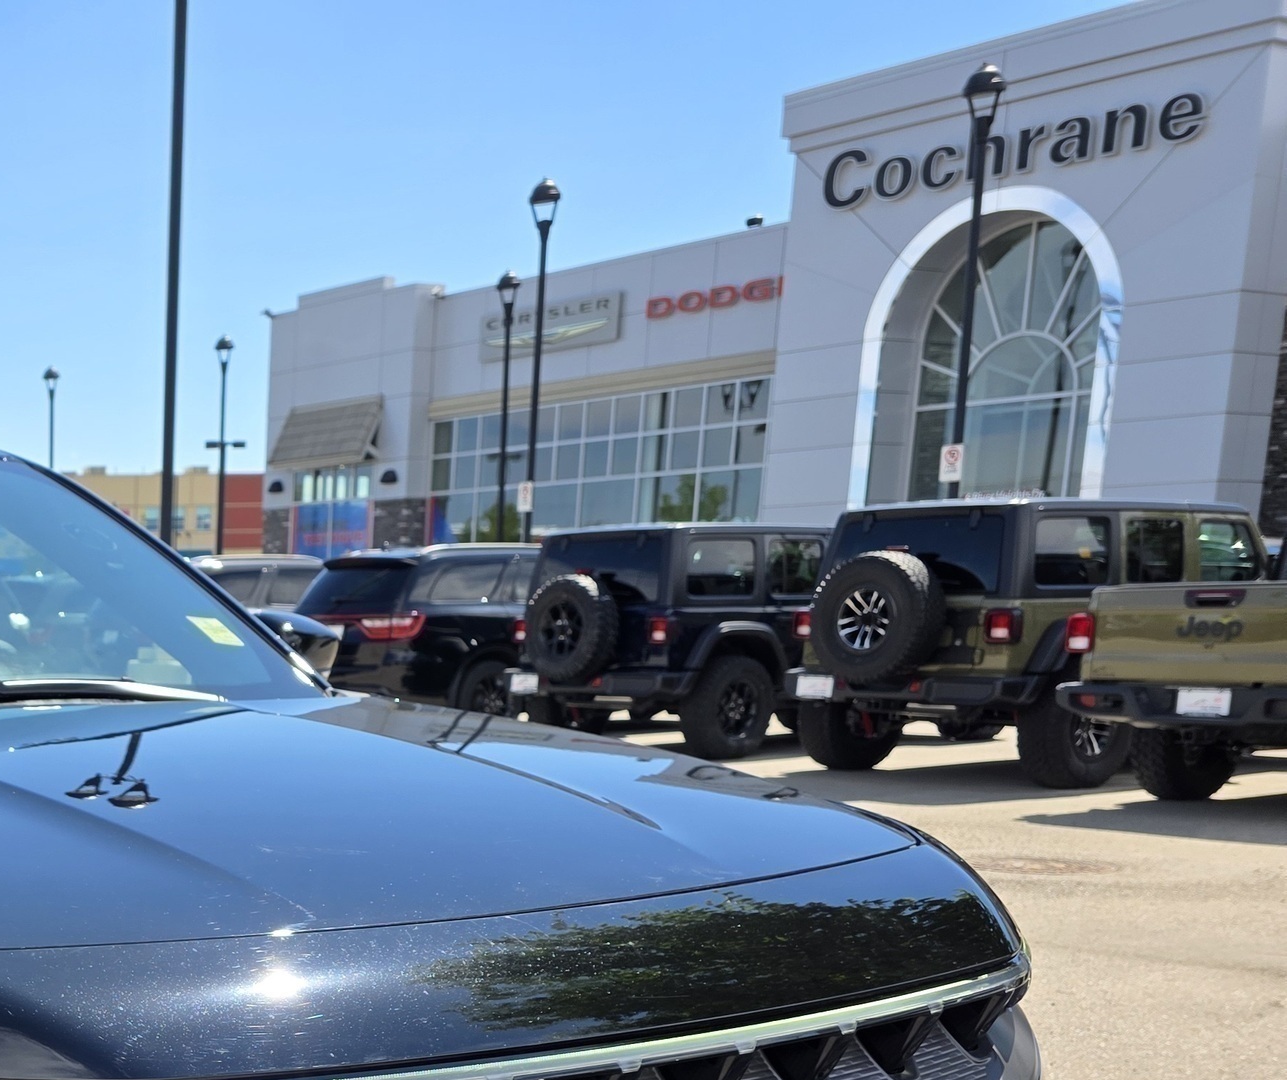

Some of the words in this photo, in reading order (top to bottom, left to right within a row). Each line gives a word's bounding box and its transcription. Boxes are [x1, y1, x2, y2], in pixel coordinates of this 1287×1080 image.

[821, 92, 1207, 210] Cochrane
[644, 276, 783, 320] DODG
[1175, 614, 1244, 642] Jeep
